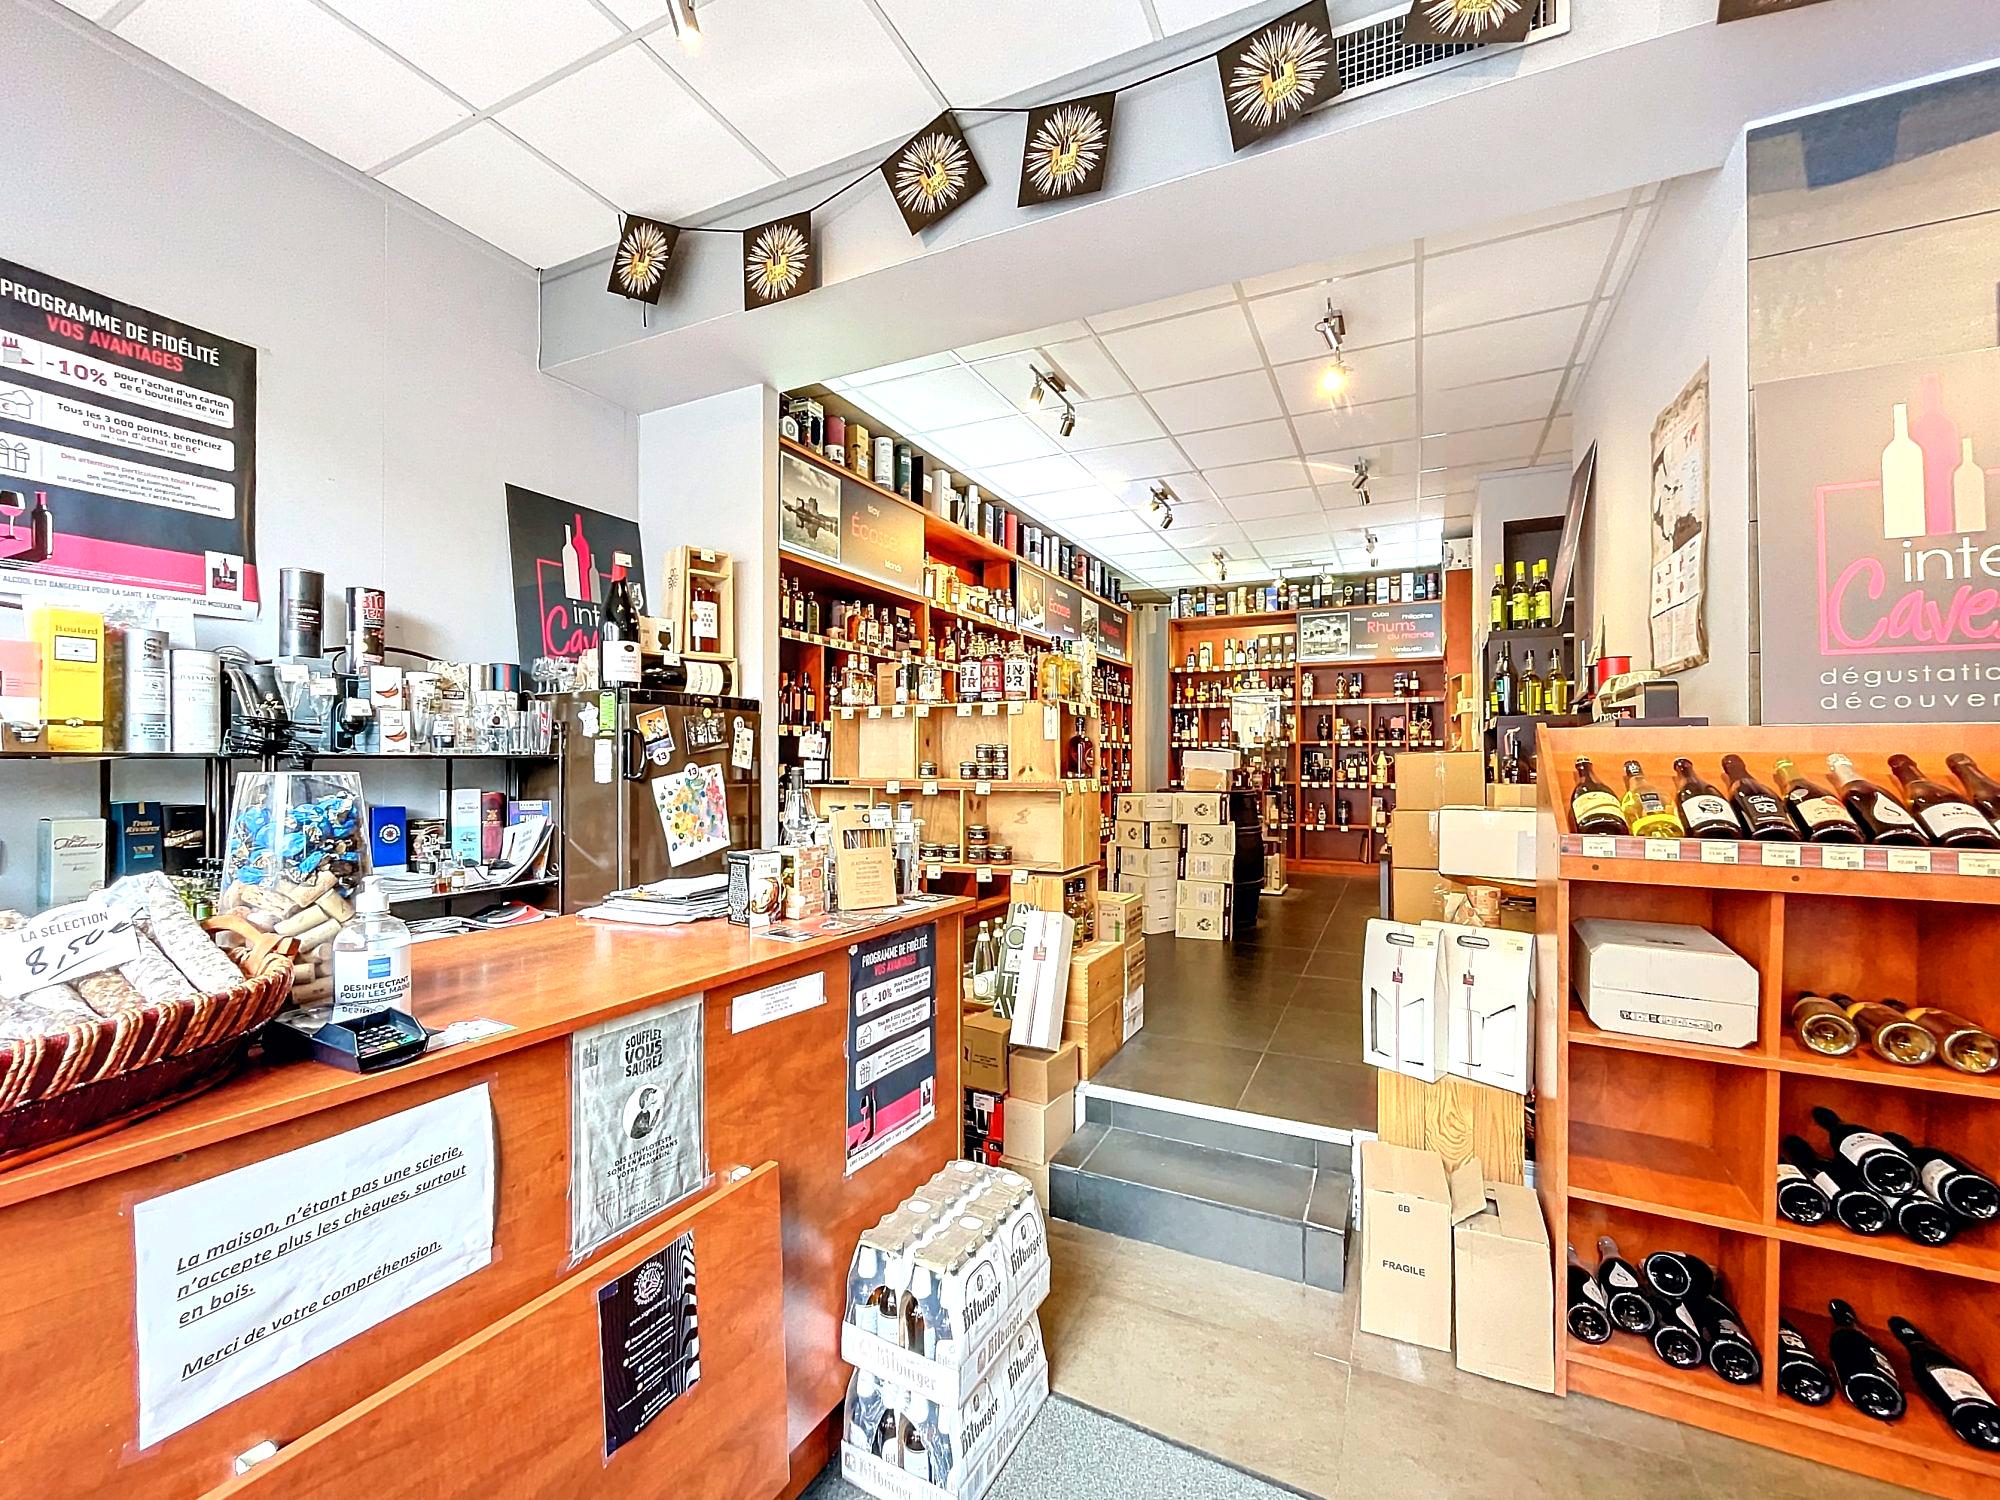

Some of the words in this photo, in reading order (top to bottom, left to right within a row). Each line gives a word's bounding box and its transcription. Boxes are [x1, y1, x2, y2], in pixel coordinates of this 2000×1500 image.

[1, 278, 121, 335] PROGRAMME
[125, 321, 148, 344] DE
[153, 330, 220, 367] FIDÉLITÉ
[46, 314, 84, 341] VOS
[89, 332, 184, 372] AVANTAGES
[46, 360, 108, 387] -10%
[114, 371, 139, 385] pour
[141, 374, 174, 393] l'achat
[176, 385, 197, 401] d'un
[199, 394, 230, 410] carton
[119, 381, 133, 391] de
[135, 383, 142, 393] 6
[145, 387, 194, 408] bouteilles
[195, 400, 208, 412] de
[209, 403, 225, 417] vin
[57, 402, 83, 416] Tous
[86, 410, 101, 420] les
[104, 415, 111, 423] 3
[82, 420, 105, 433] d'un
[108, 427, 129, 437] bon
[131, 432, 168, 447] d'achat
[170, 441, 183, 450] de
[1903, 537, 2000, 583] inte
[573, 601, 600, 627] int
[1830, 557, 2000, 648] Cave
[546, 606, 599, 654] Cav
[1367, 621, 1416, 633] Rhums
[1402, 632, 1435, 640] monde
[1820, 663, 2000, 688] dégustatio
[1820, 692, 2000, 710] découver
[656, 752, 668, 761] 13
[687, 767, 697, 776] 13
[20, 931, 38, 943] LA
[41, 912, 109, 938] SELECTION
[368, 989, 386, 998] LES
[625, 1040, 662, 1064] VOUS
[626, 1029, 661, 1050] SOUFFLEZ
[626, 1053, 663, 1077] SAUREZ
[607, 1164, 626, 1177] SONT
[628, 1159, 637, 1168] EN
[660, 1139, 678, 1151] DANS
[615, 1155, 626, 1167] DES
[617, 1167, 638, 1180] VOTRE
[177, 1253, 199, 1271] La
[207, 1222, 280, 1259] maison,
[351, 1179, 379, 1200] pas
[383, 1166, 412, 1185] une
[415, 1146, 464, 1173] scierie,
[278, 1231, 312, 1257] plus
[317, 1218, 339, 1237] les
[344, 1191, 411, 1225] chèques,
[415, 1164, 467, 1193] surtout
[1010, 1233, 1042, 1277] Bitburger
[1382, 1259, 1426, 1277] FRAGILE
[179, 1307, 203, 1325] en
[210, 1283, 255, 1310] bois.
[182, 1338, 239, 1378] Merci
[244, 1323, 266, 1344] de
[272, 1301, 318, 1329] votre
[322, 1241, 443, 1306] compréhension.
[962, 1281, 1001, 1334] Bitburger
[987, 1308, 1023, 1364] Bitburger
[1007, 1339, 1040, 1391] Bitburger
[960, 1397, 999, 1459] Bitburger
